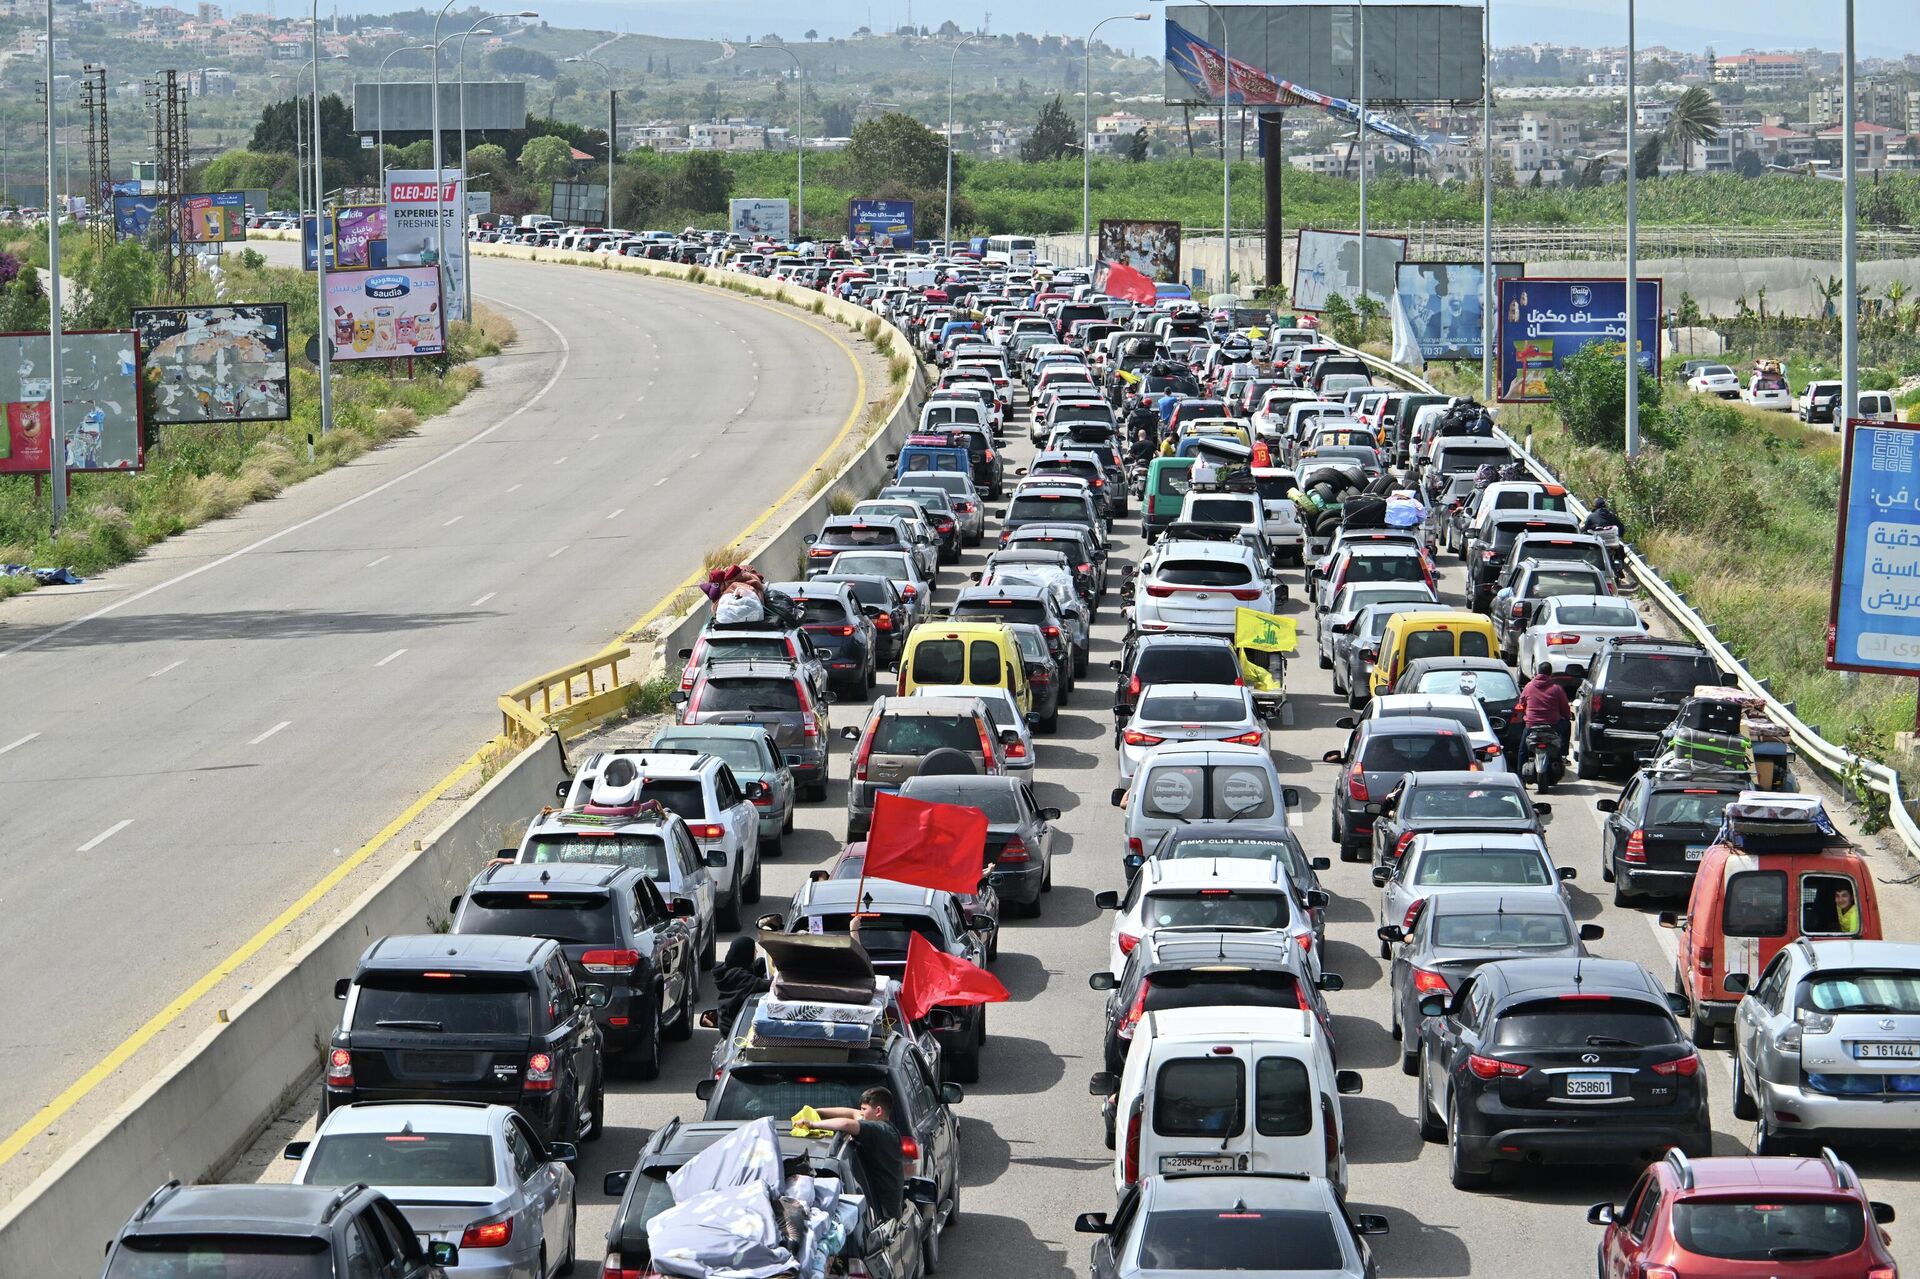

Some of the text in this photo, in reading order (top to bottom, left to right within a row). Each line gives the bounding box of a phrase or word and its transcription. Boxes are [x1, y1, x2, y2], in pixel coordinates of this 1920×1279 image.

[393, 185, 453, 200] CLEO-DET
[394, 209, 454, 218] EXPERIENCE
[398, 219, 451, 228] FRESHNES
[373, 289, 403, 298] saudia
[1572, 287, 1589, 297] Daily
[1570, 310, 1627, 323] عرض
[160, 319, 176, 327] The
[1527, 323, 1627, 337] مضان
[1874, 526, 1920, 550] دقية
[1871, 556, 1920, 580] اسبة
[1867, 588, 1920, 611] مريض
[1828, 626, 1836, 641] 365
[1238, 839, 1284, 847] LEBANON
[1862, 1045, 1913, 1056] S 161444
[1567, 1081, 1610, 1093] S258601
[1171, 1158, 1203, 1167] 220542
